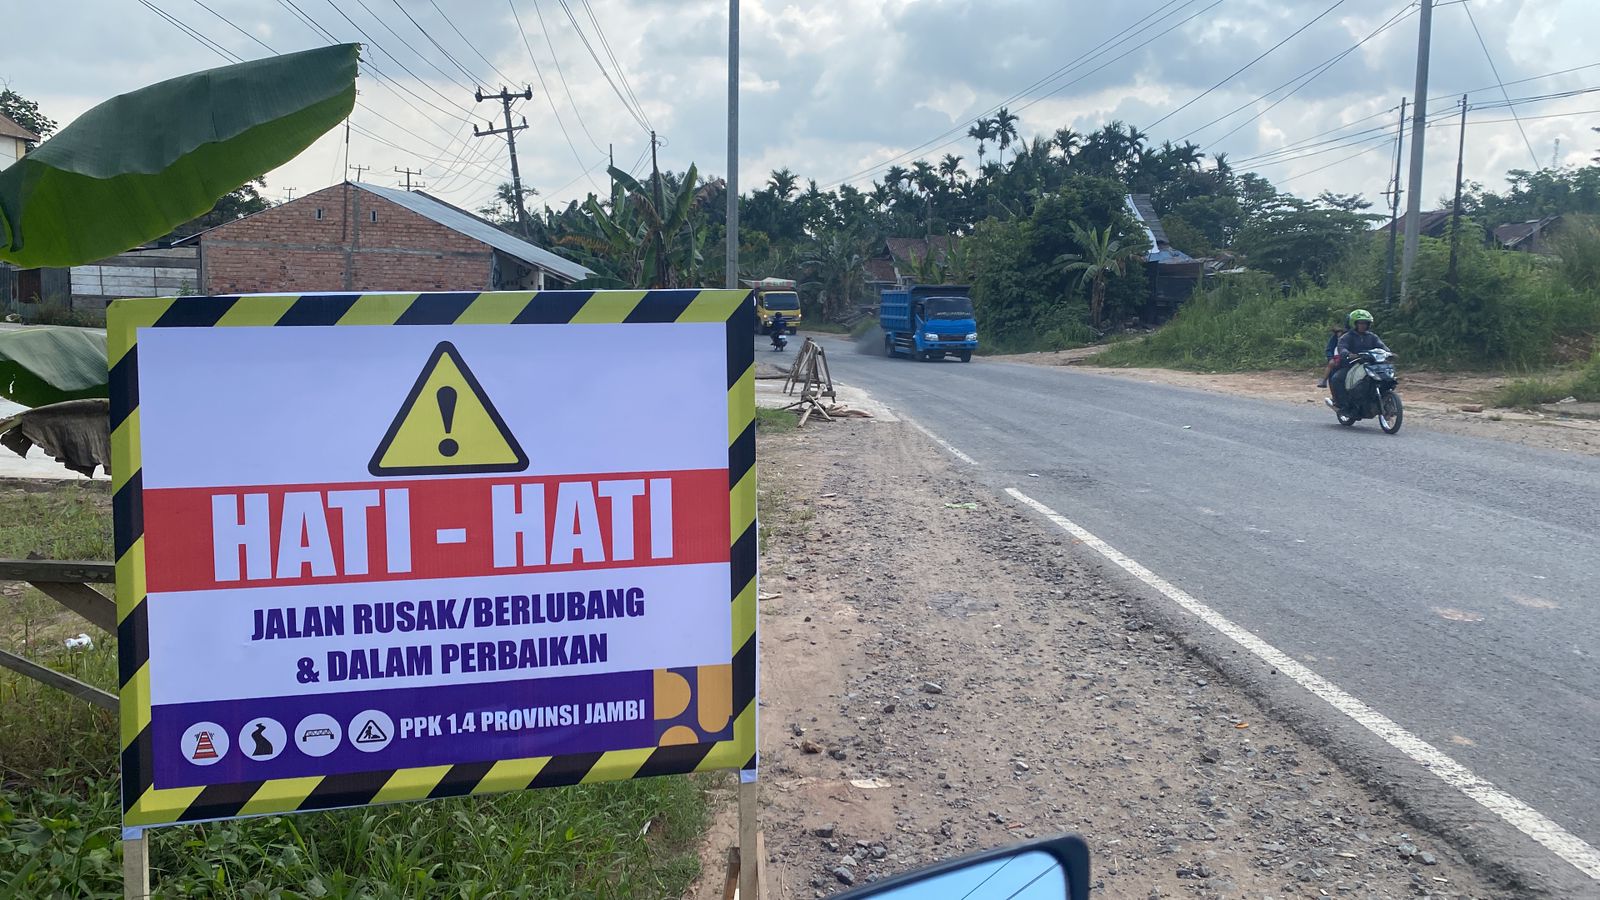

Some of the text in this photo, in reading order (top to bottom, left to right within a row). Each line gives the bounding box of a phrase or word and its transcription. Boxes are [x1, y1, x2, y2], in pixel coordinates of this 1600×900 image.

[211, 478, 673, 582] HATI - HATI
[251, 587, 645, 641] JALAN RUSAK/BERLUBANG
[296, 633, 608, 684] & DALAM PERBAIKAN
[400, 699, 646, 739] PPK 1.4 PROVINSI JAMBI
